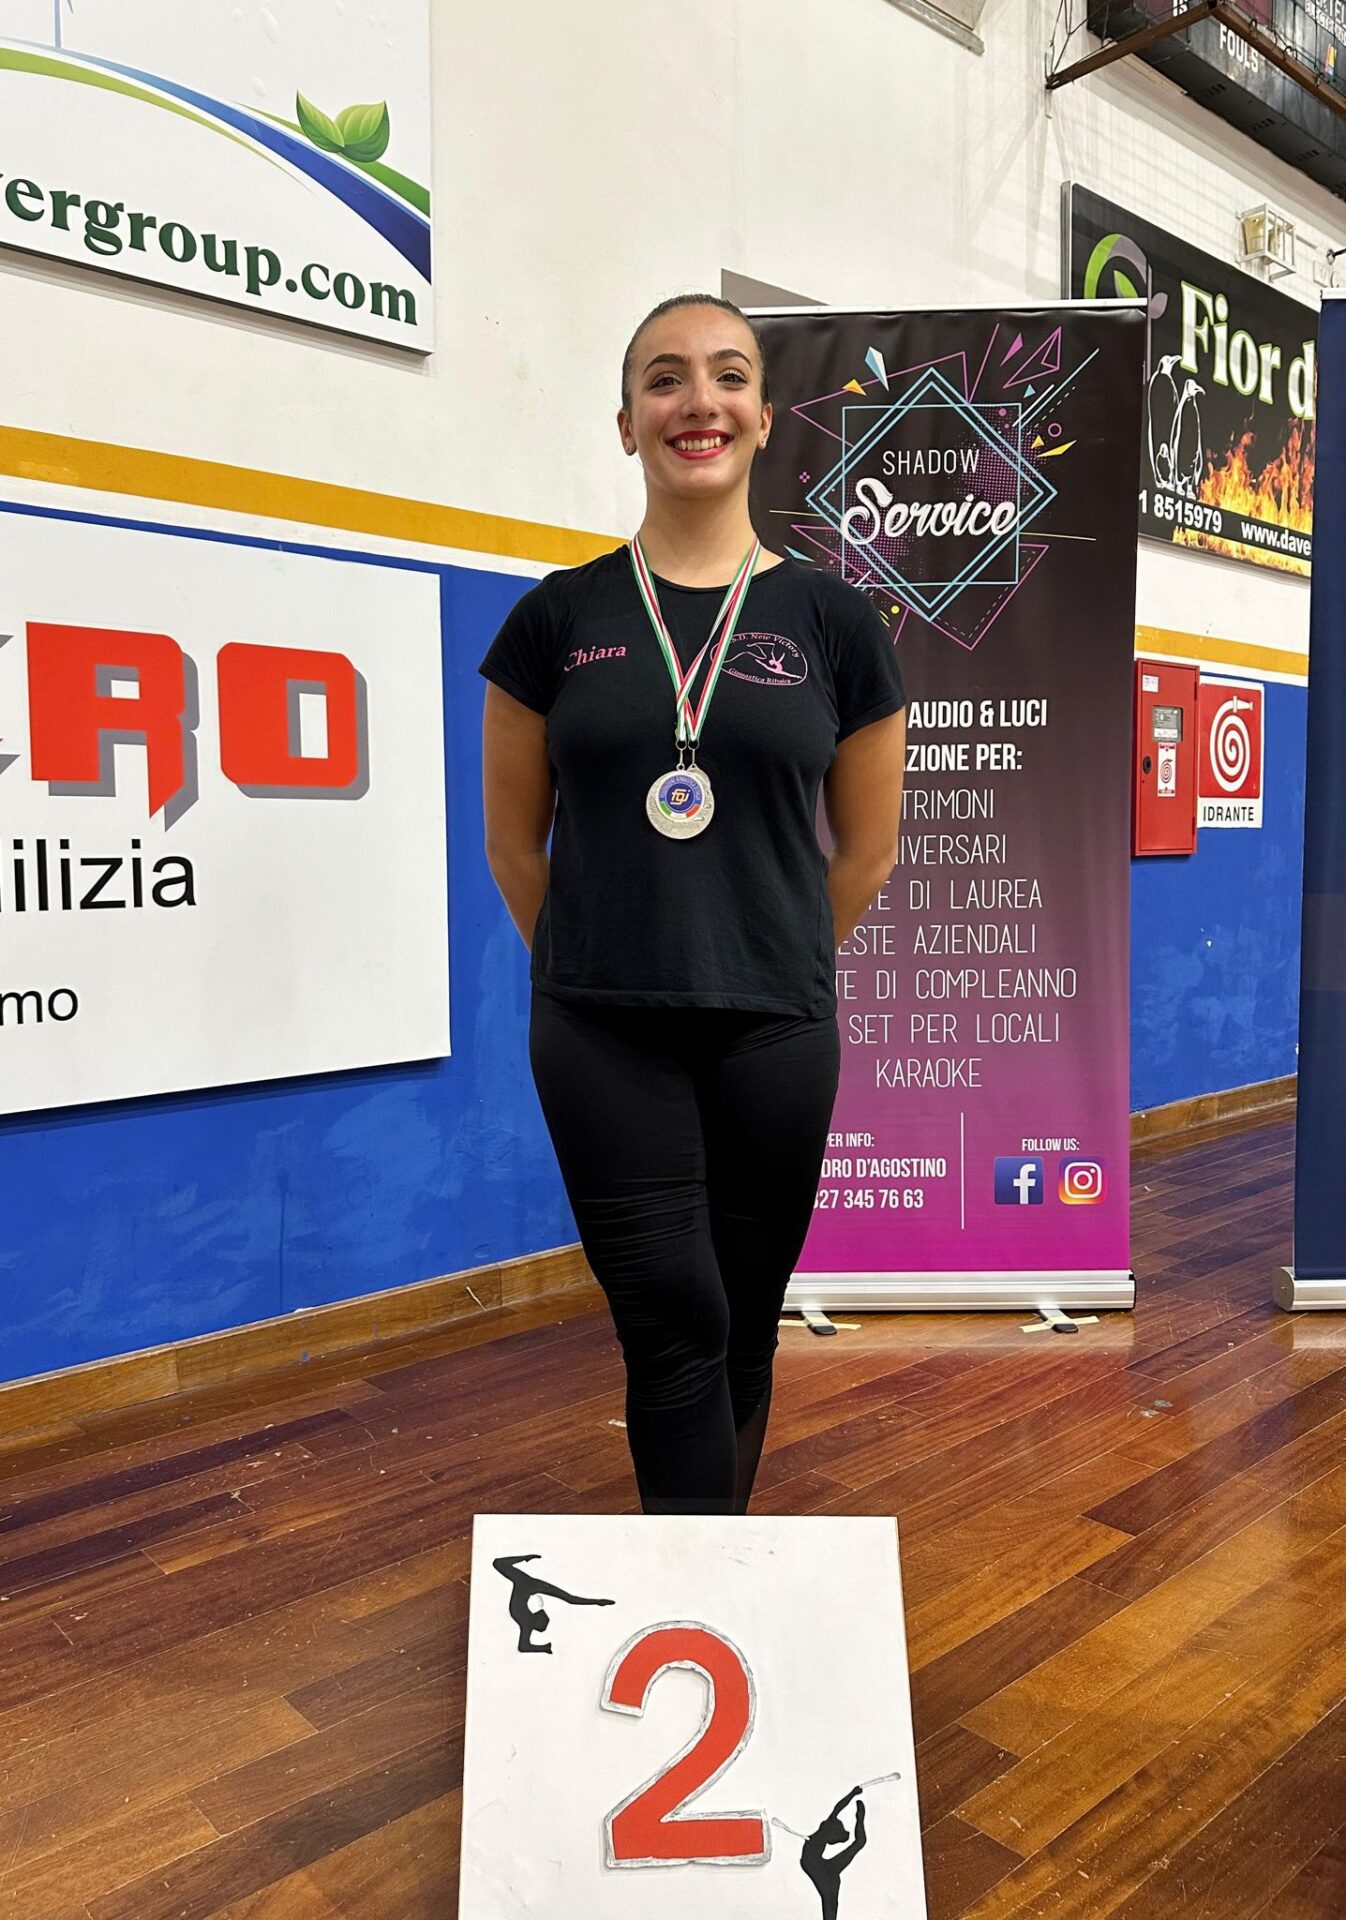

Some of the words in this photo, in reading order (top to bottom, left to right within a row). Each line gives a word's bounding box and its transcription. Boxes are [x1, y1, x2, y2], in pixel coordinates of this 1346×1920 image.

[1219, 22, 1259, 73] FOULS
[0, 172, 418, 326] ergroup.com
[1180, 280, 1281, 405] Fior
[882, 449, 980, 475] SHADOW
[840, 477, 1022, 545] Service
[1153, 493, 1222, 533] 8515979
[1241, 521, 1312, 556] www.dave
[563, 645, 627, 672] Chiara
[773, 634, 800, 658] Victory
[0, 621, 369, 832] RO
[908, 700, 973, 729] AUDIO
[979, 700, 994, 727] &
[1000, 699, 1048, 727] LUCI
[903, 744, 970, 772] ZIONE
[976, 743, 1023, 771] PER:
[902, 789, 994, 820] TRIMONI
[1202, 805, 1255, 822] IDRANTE
[895, 833, 1007, 865] IVERSARI
[0, 838, 197, 912] ilizia
[867, 880, 892, 911] E
[909, 879, 931, 910] DI
[950, 878, 1043, 910] LAUREA
[913, 923, 1037, 955] AZIENDALI
[876, 969, 897, 1000] DI
[916, 968, 1078, 1000] COMPLEANNO
[848, 1014, 894, 1045] SET
[910, 1013, 958, 1044] PER
[976, 1012, 1060, 1043] LOCALI
[876, 1057, 983, 1089] KARAOKE
[826, 1132, 844, 1147] ER
[845, 1132, 875, 1147] INFO:
[1021, 1138, 1061, 1151] FOLLOW
[1063, 1138, 1080, 1151] US:
[821, 1158, 852, 1178] DRO
[856, 1158, 947, 1179] D'AGOSTINO
[843, 1189, 875, 1209] 345
[878, 1189, 900, 1209] 76
[903, 1189, 924, 1209] 63
[600, 1619, 773, 1869] 2
